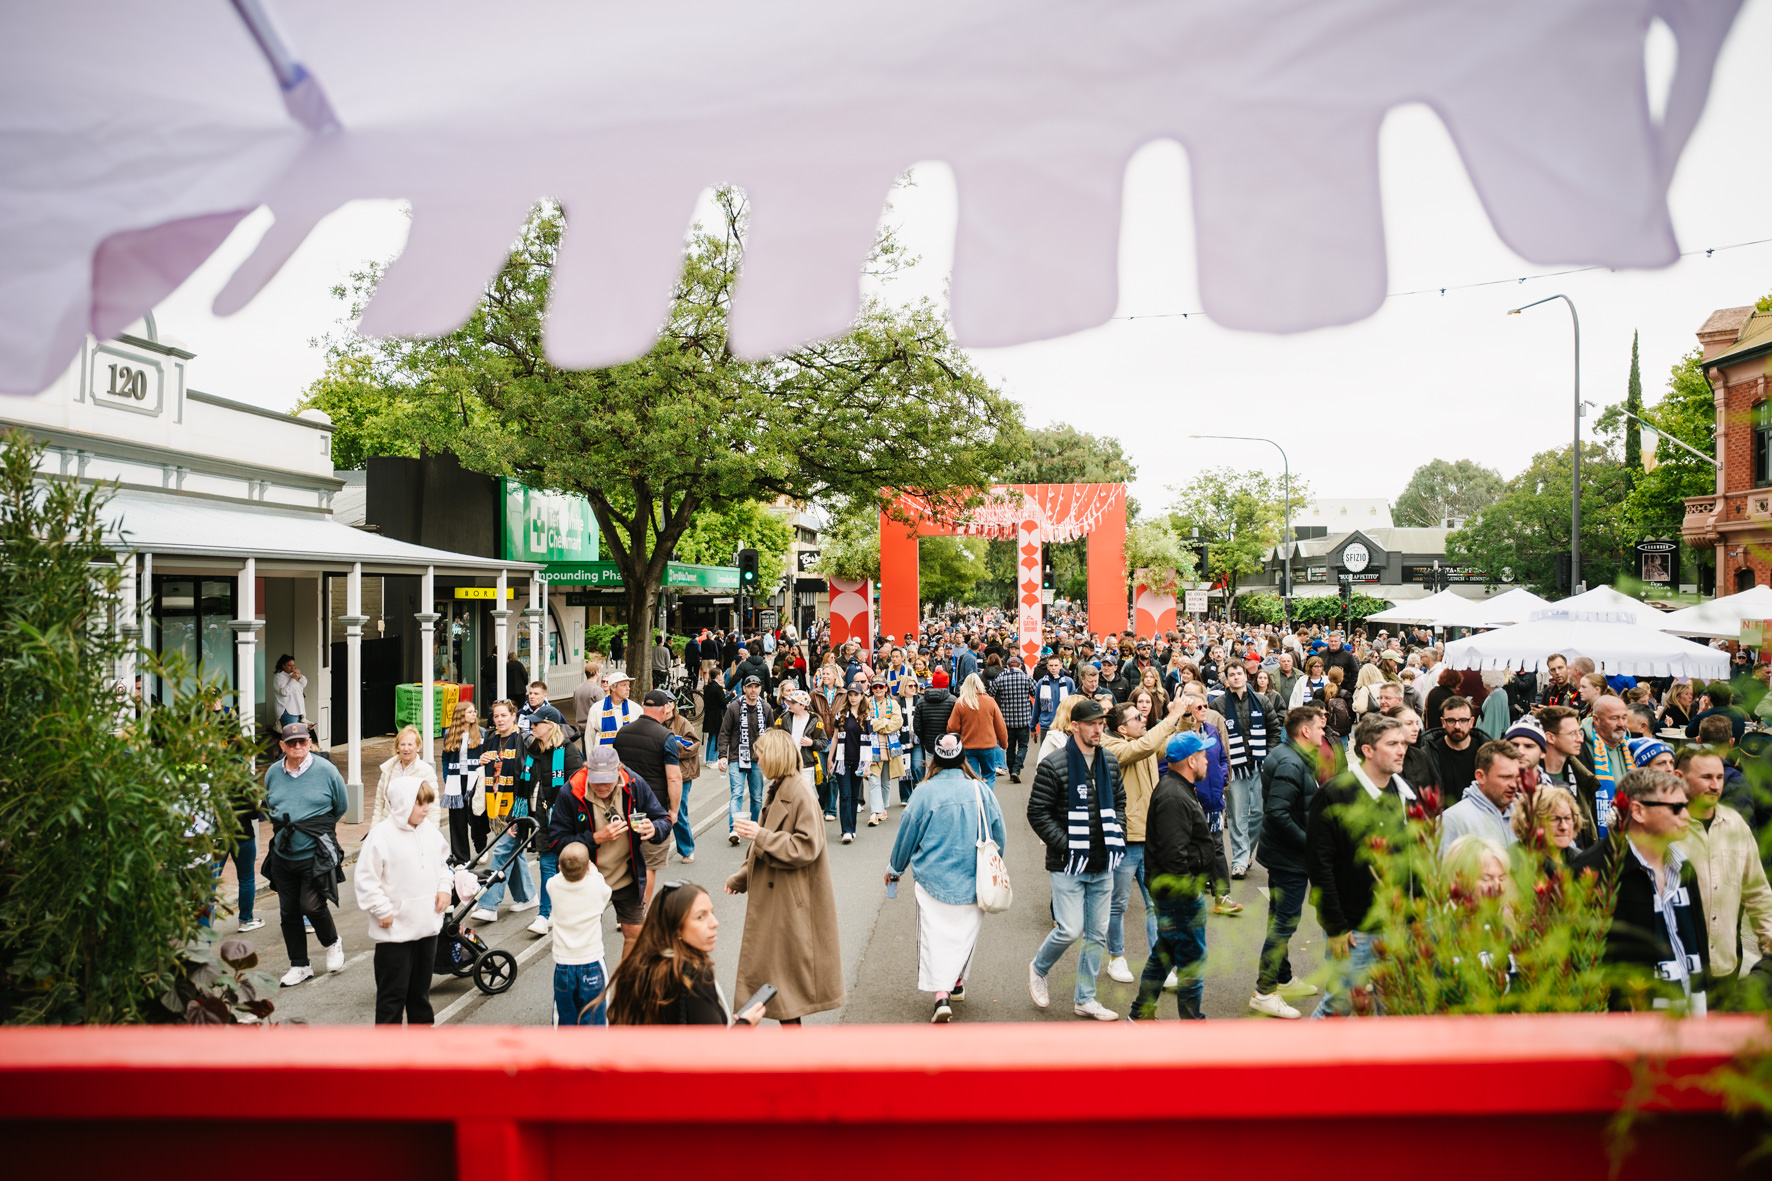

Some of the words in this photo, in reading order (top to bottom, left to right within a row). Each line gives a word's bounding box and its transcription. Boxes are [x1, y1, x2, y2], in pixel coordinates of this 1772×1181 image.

[107, 364, 147, 400] 120
[1346, 554, 1366, 562] SFIZIO
[538, 570, 598, 582] mpounding
[1641, 750, 1657, 761] BIG
